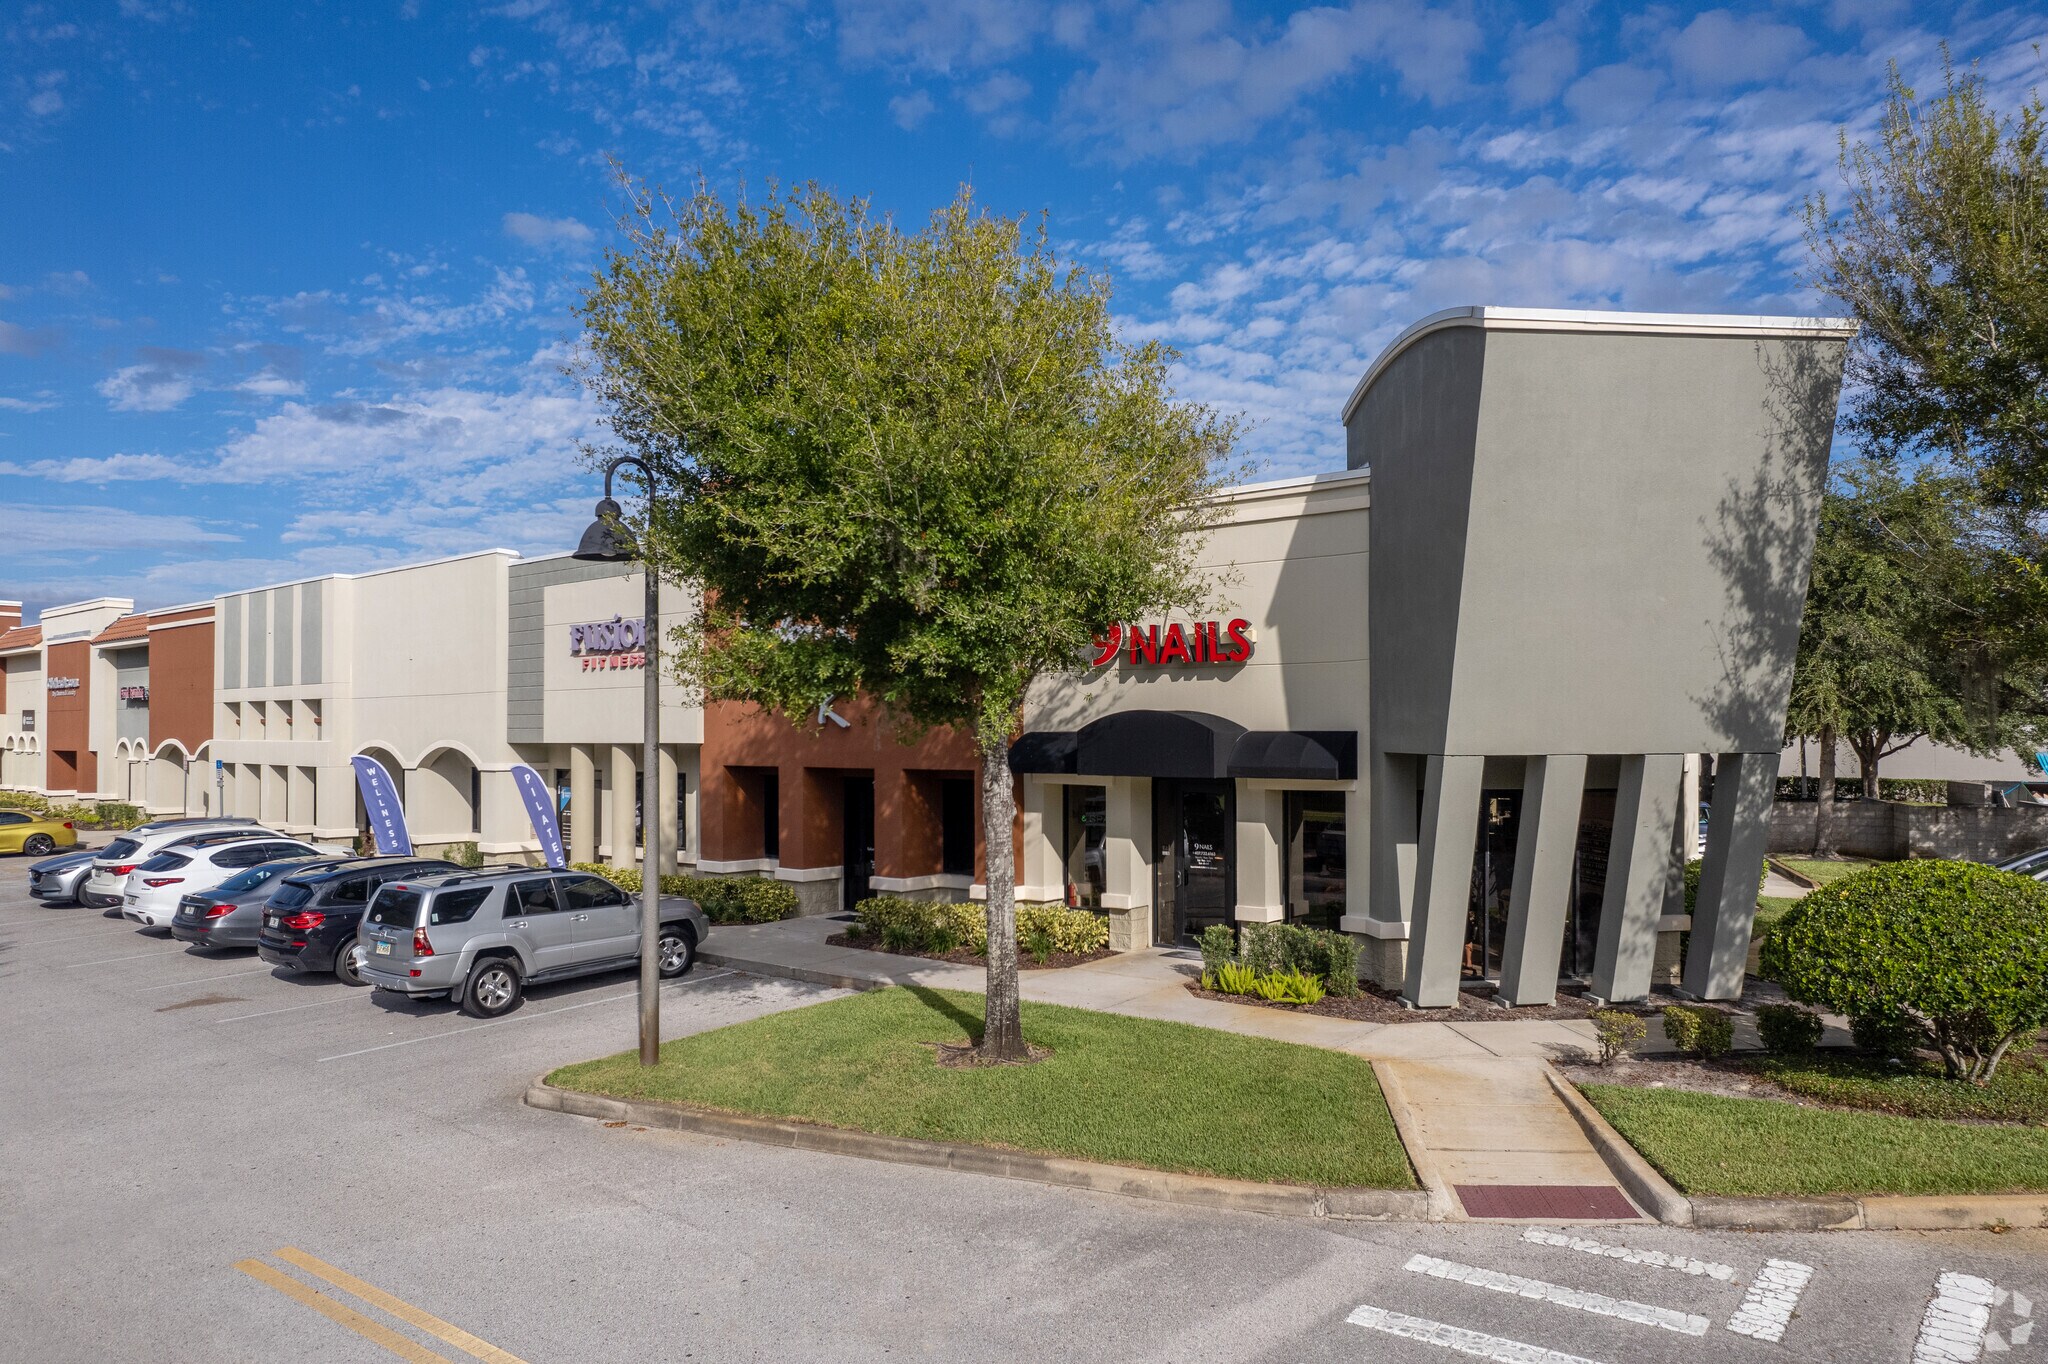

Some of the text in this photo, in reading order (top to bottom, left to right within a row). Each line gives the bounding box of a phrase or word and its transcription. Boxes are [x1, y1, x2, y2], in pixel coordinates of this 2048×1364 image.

[582, 654, 646, 669] FITNESS
[1092, 618, 1252, 667] 9 NAILS
[366, 767, 398, 848] WELLNESS
[524, 773, 564, 867] PILATES
